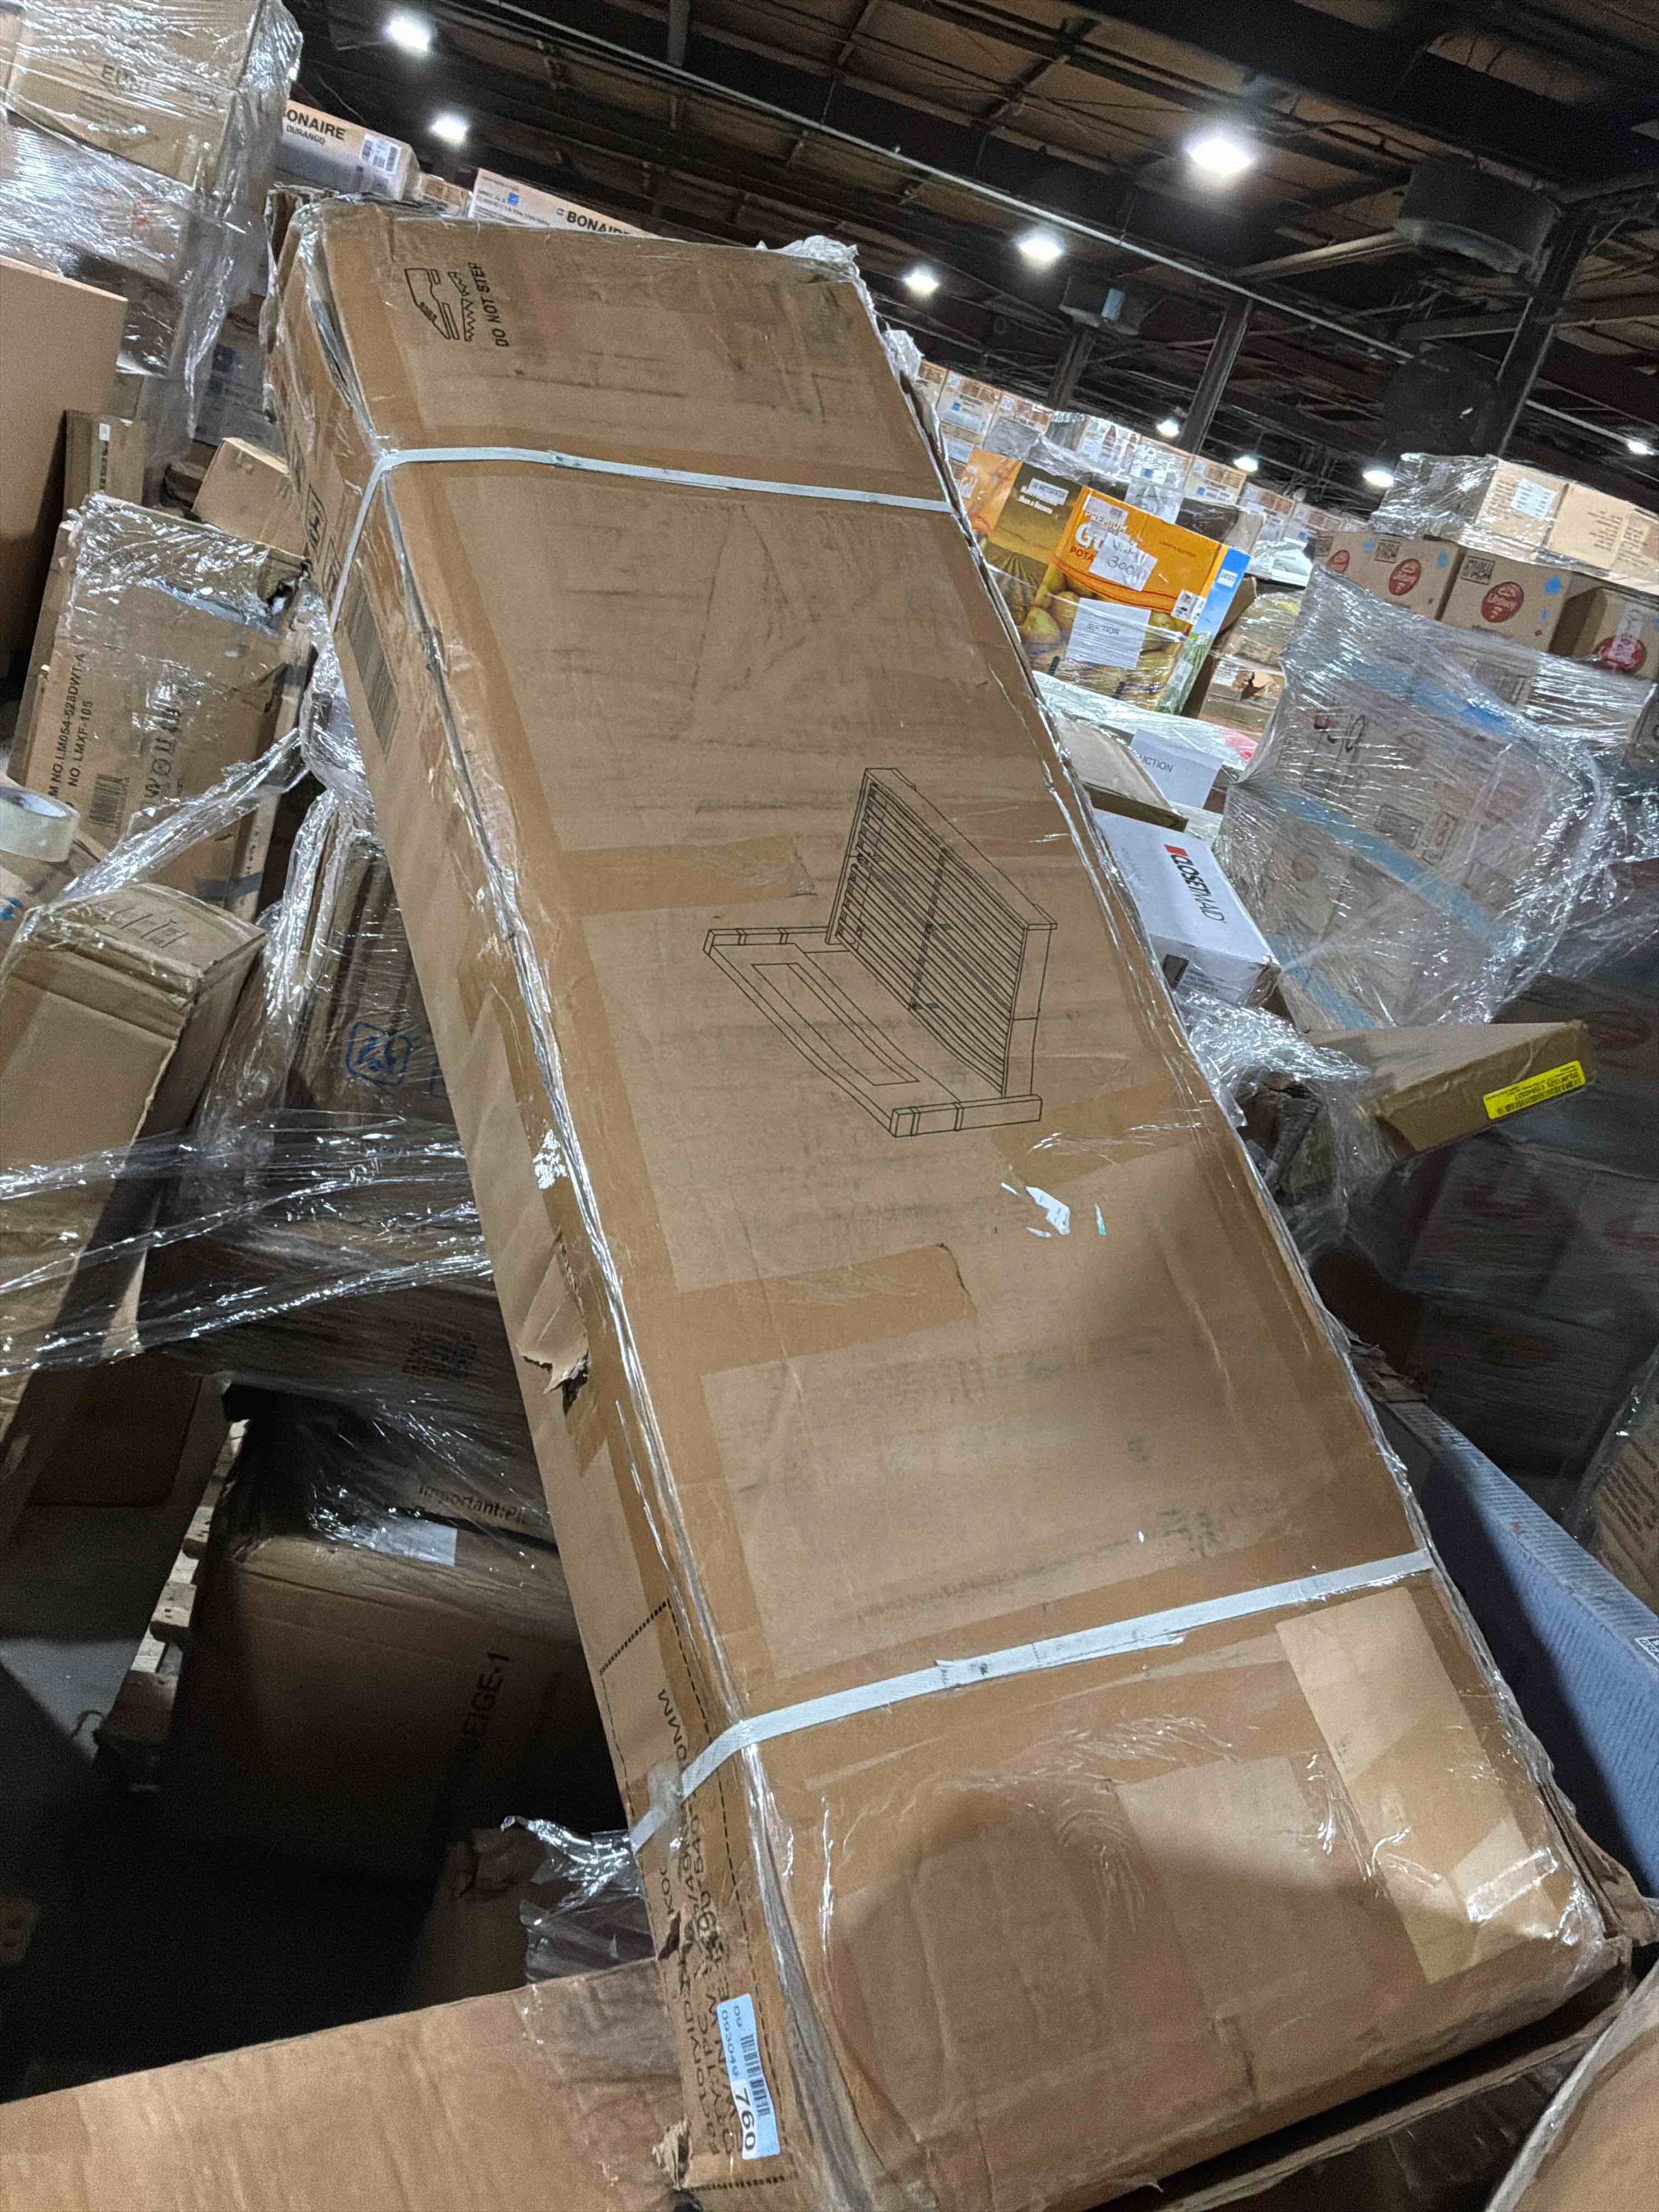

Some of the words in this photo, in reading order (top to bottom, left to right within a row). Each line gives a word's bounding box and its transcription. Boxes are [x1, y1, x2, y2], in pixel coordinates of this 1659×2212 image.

[284, 109, 346, 140] ONAIRE
[467, 262, 490, 293] STEP
[480, 296, 500, 323] NOT
[493, 329, 510, 347] DO
[1084, 510, 1128, 533] PREMIUM
[1070, 546, 1095, 561] POTA
[1171, 854, 1225, 921] CLOSETMAID
[735, 2088, 757, 2151] 760
